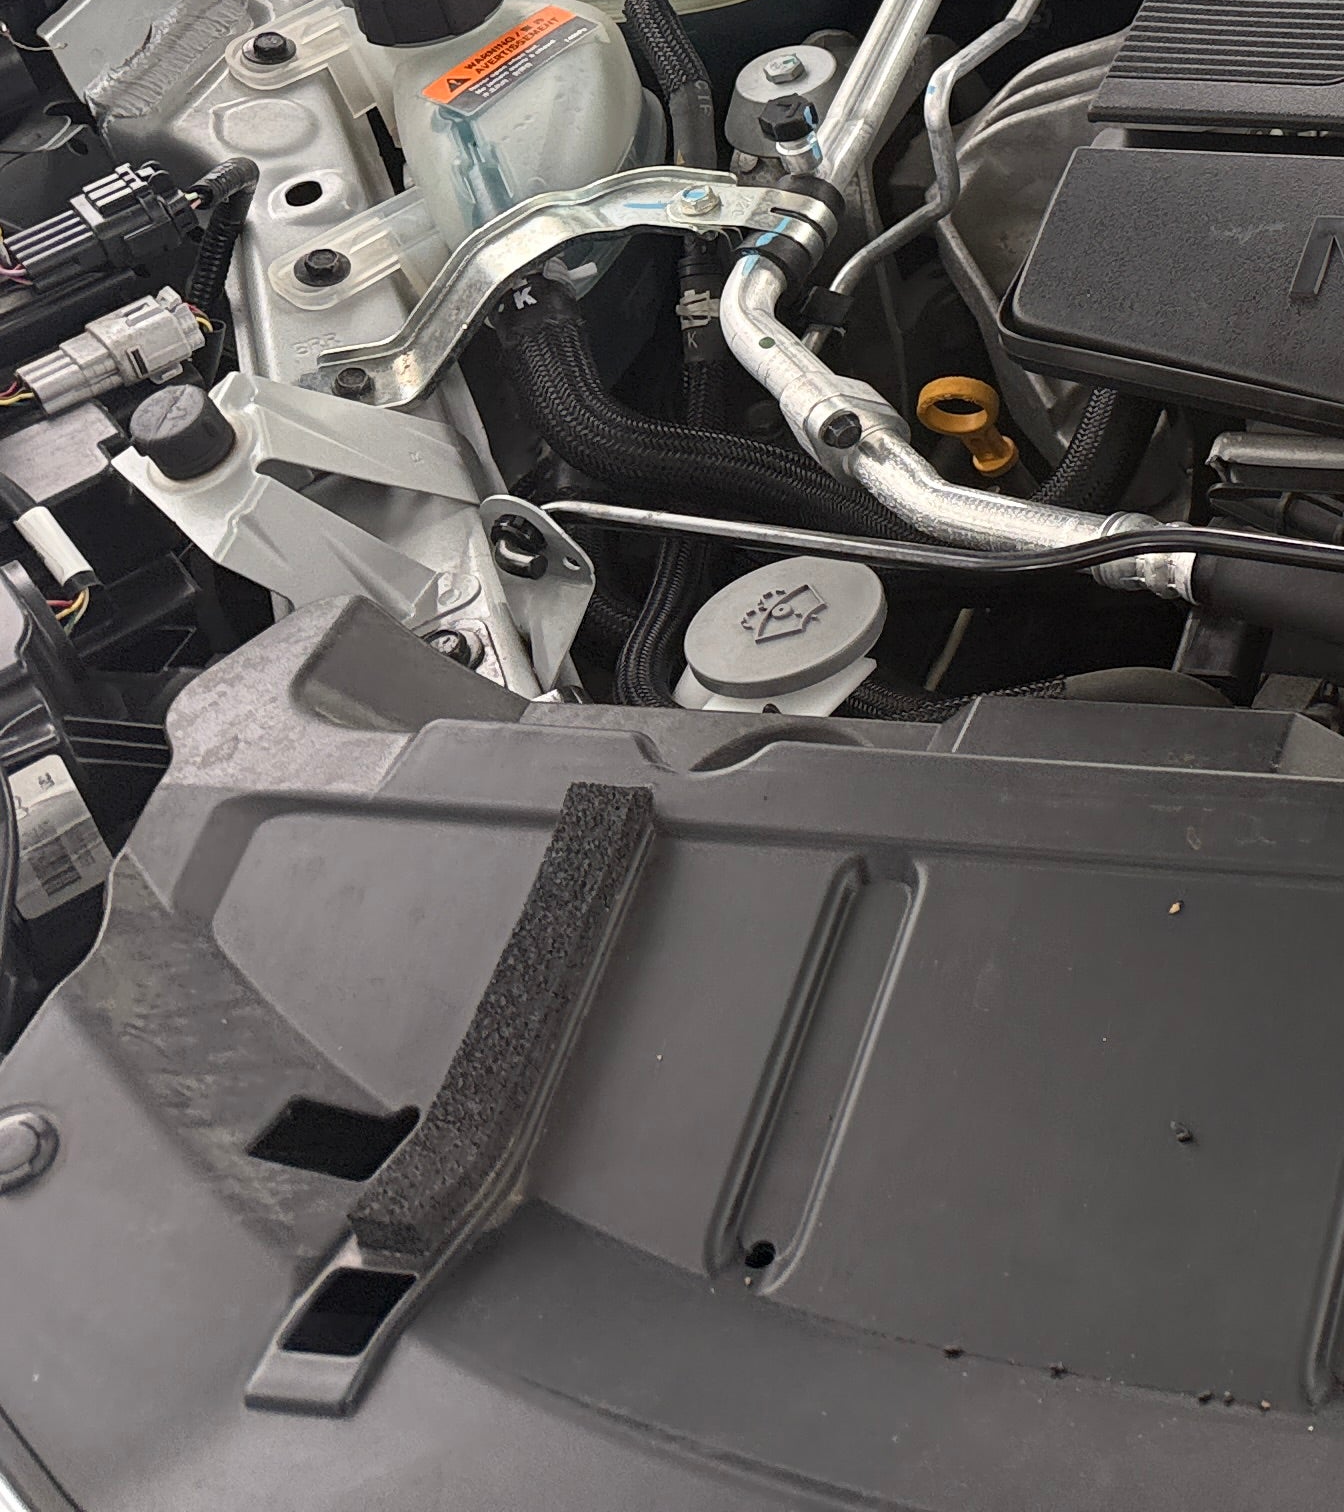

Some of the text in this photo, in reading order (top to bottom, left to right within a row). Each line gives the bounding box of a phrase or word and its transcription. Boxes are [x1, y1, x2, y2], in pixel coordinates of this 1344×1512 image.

[464, 36, 516, 71] WARNING
[475, 16, 559, 75] AVERTISSEMENT
[513, 286, 538, 309] K
